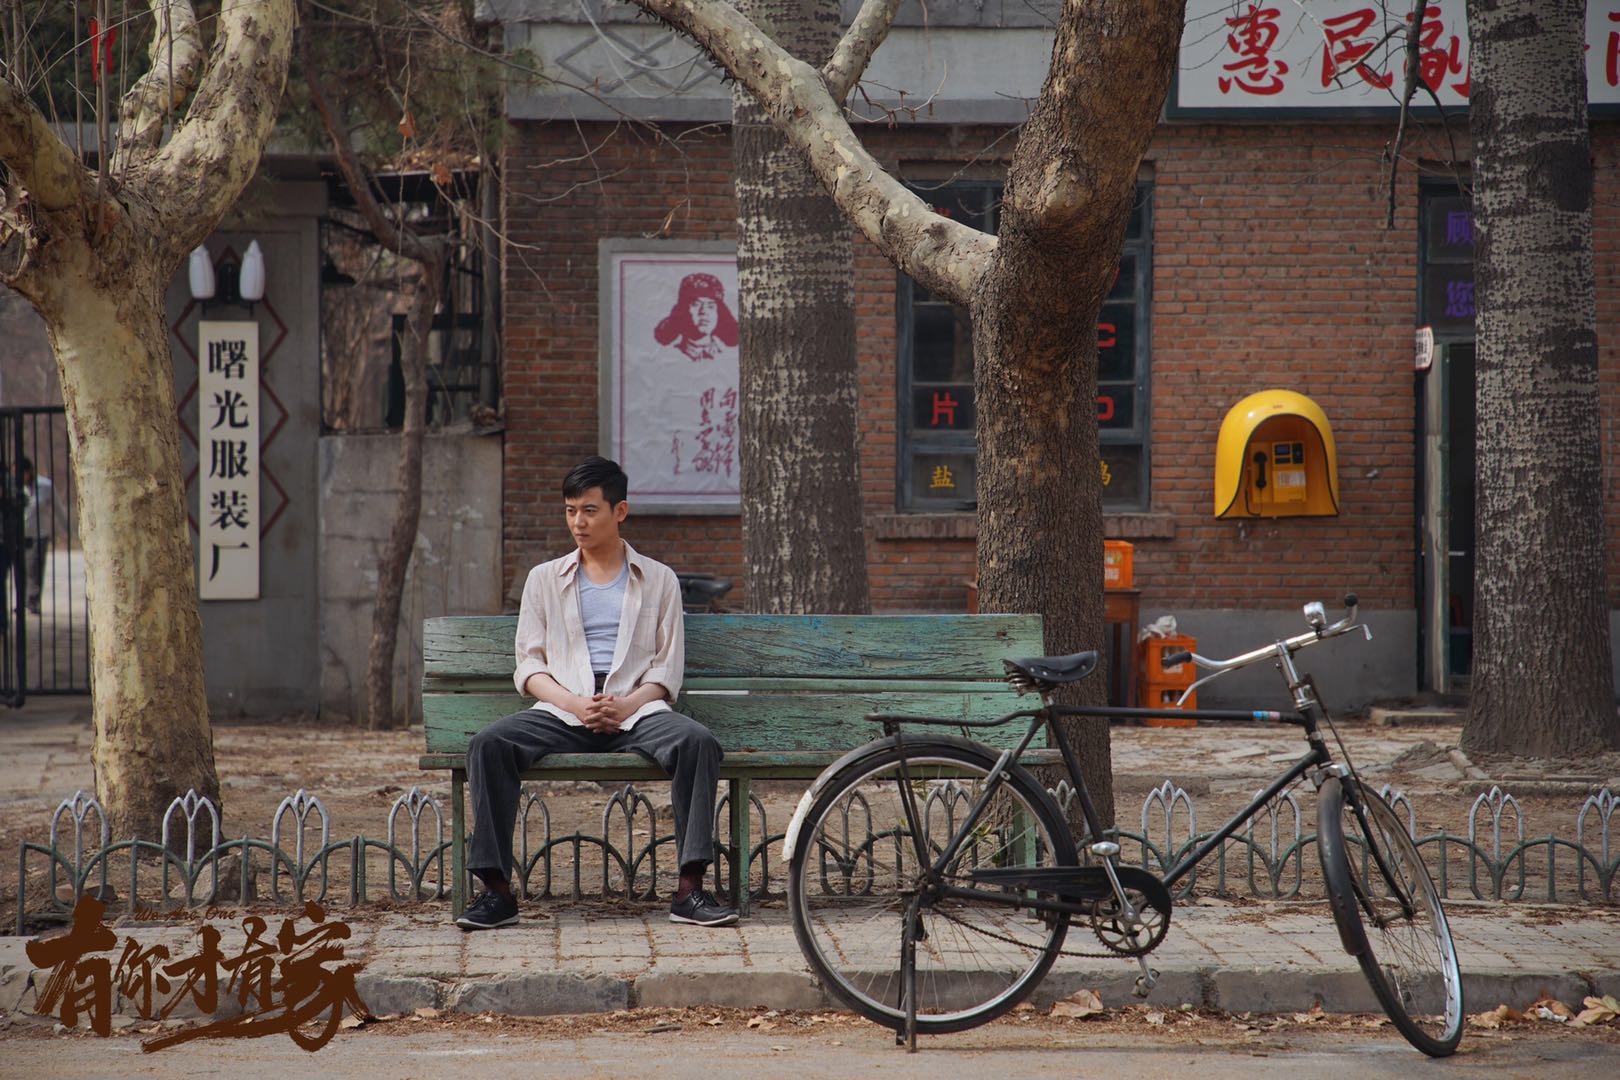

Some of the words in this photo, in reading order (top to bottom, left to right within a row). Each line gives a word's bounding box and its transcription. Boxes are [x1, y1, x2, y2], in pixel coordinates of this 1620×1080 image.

[931, 392, 958, 426] 片
[208, 339, 250, 582] 曙光服装厂
[930, 465, 955, 488] 盐
